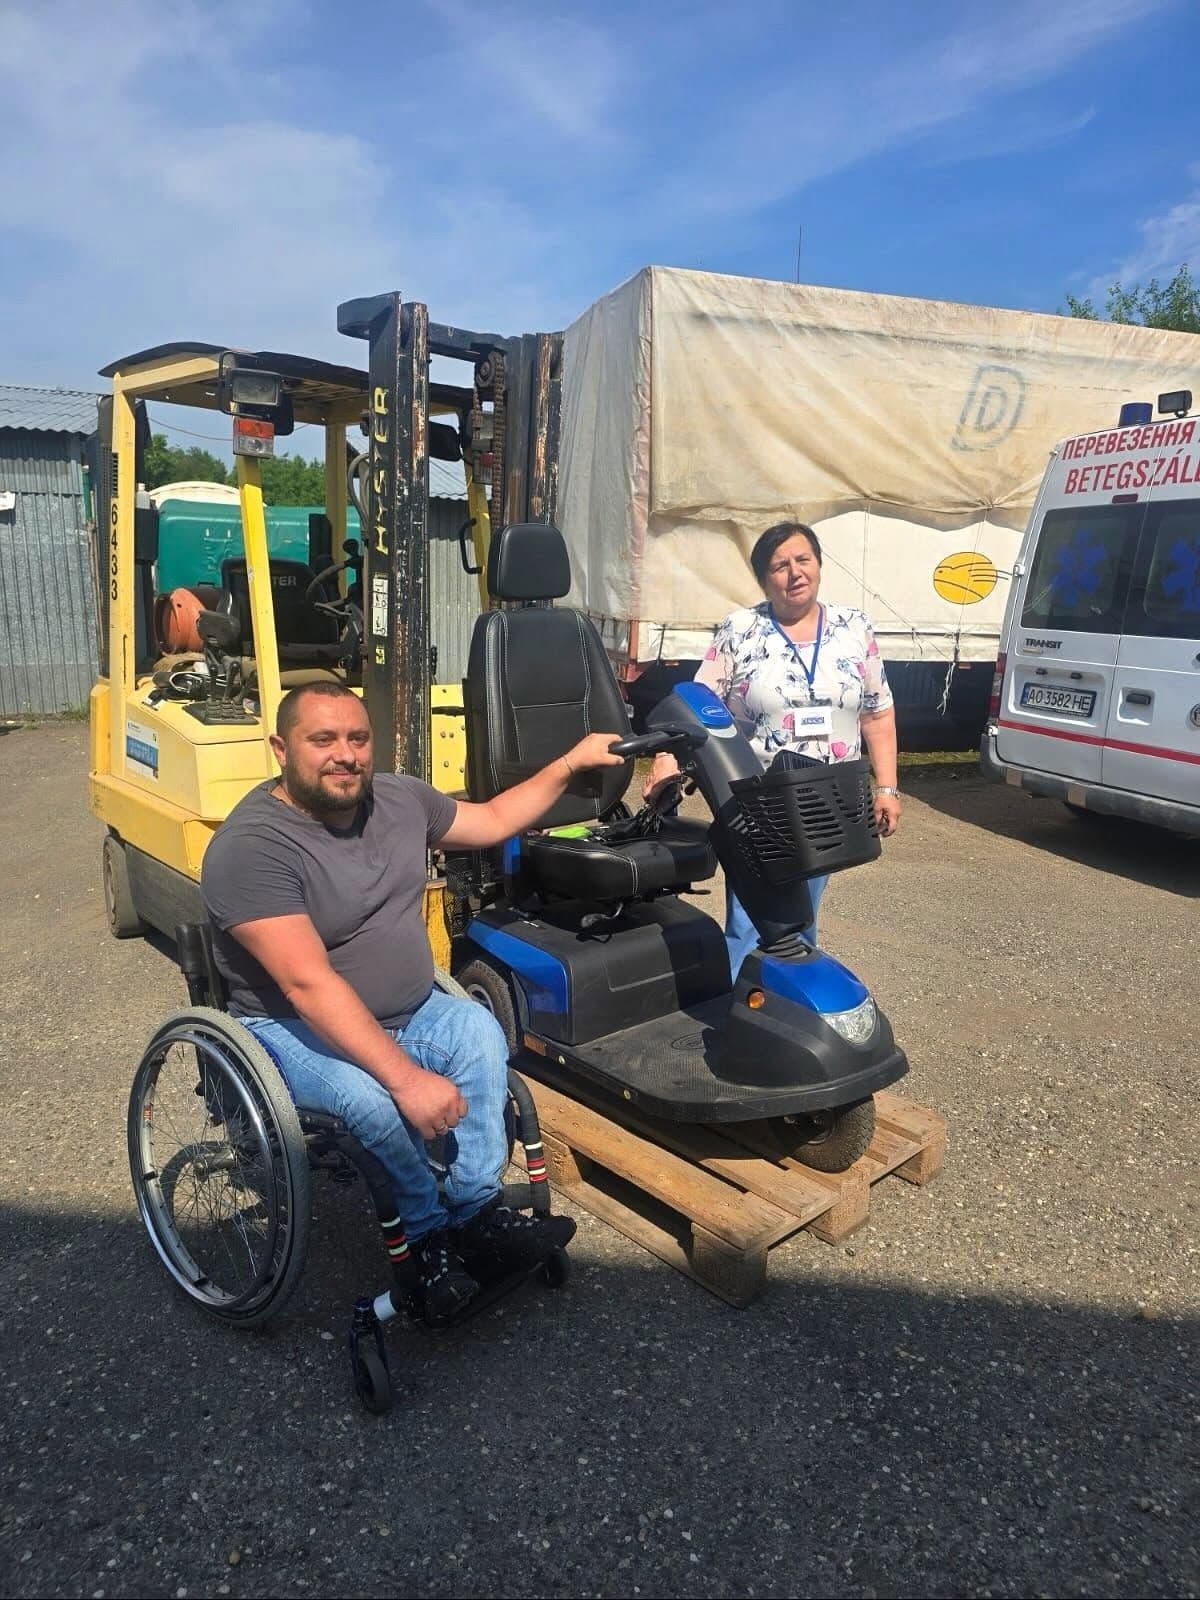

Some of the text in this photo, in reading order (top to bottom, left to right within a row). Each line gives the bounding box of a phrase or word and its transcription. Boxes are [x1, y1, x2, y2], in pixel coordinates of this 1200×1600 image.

[1062, 420, 1197, 461] ПЕРЕВЕЗЕННЯ
[1025, 638, 1063, 649] TRANSIT
[1044, 690, 1072, 707] 3582
